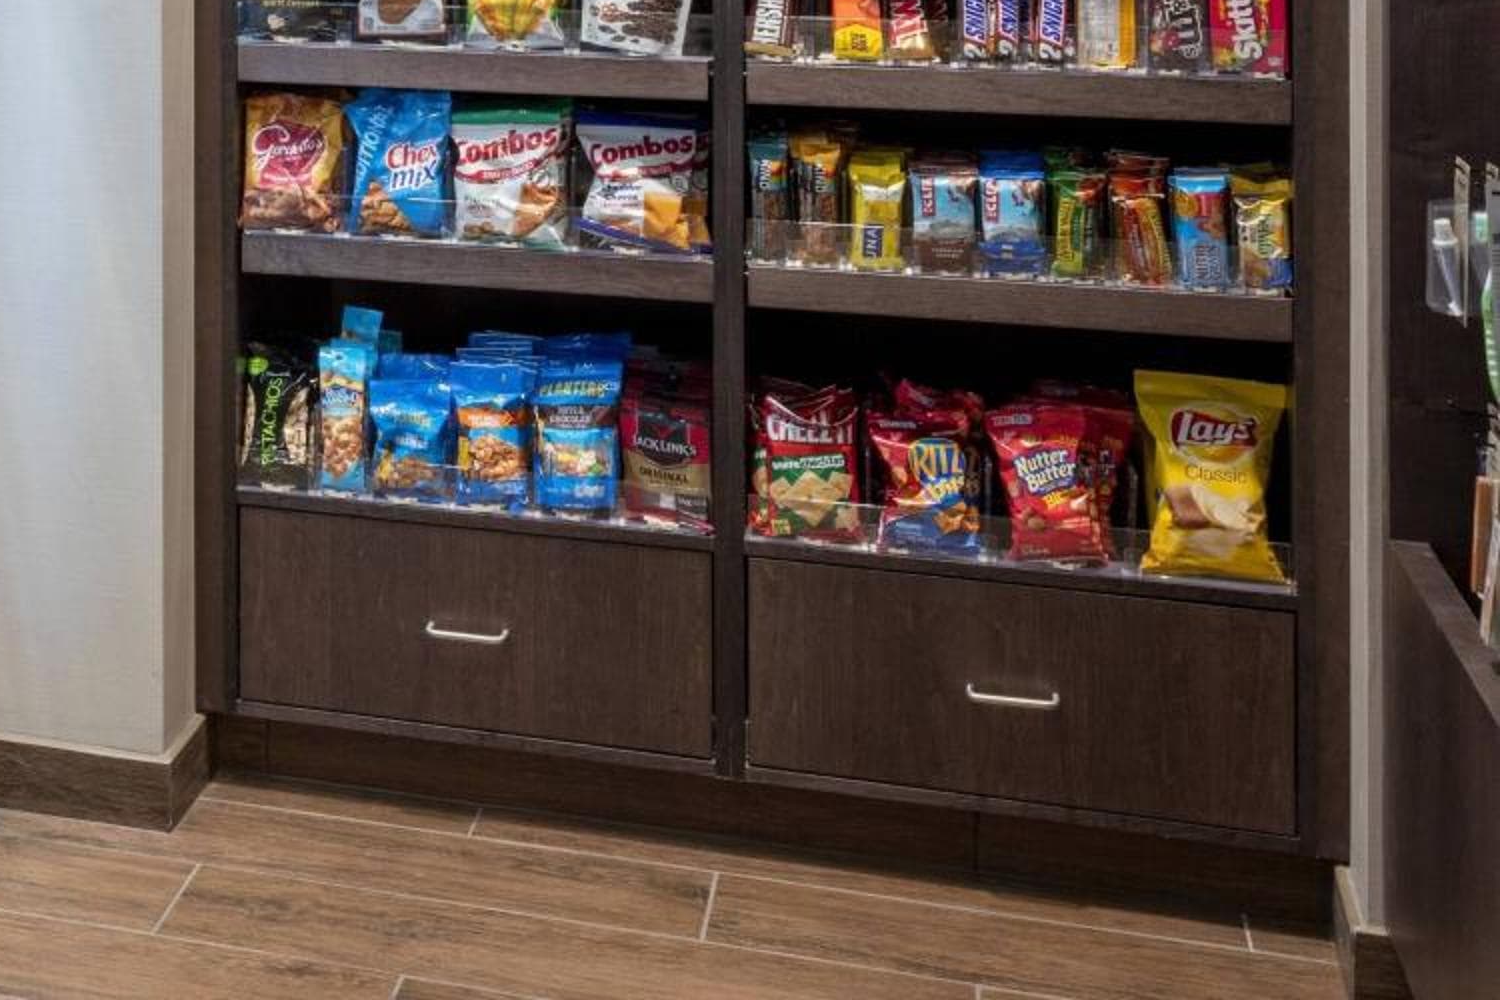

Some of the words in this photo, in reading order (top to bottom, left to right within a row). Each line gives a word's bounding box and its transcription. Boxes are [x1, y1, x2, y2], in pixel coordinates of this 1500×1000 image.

[1177, 410, 1255, 444] Lay's
[1014, 449, 1068, 478] Nutter
[1026, 463, 1076, 493] Butter
